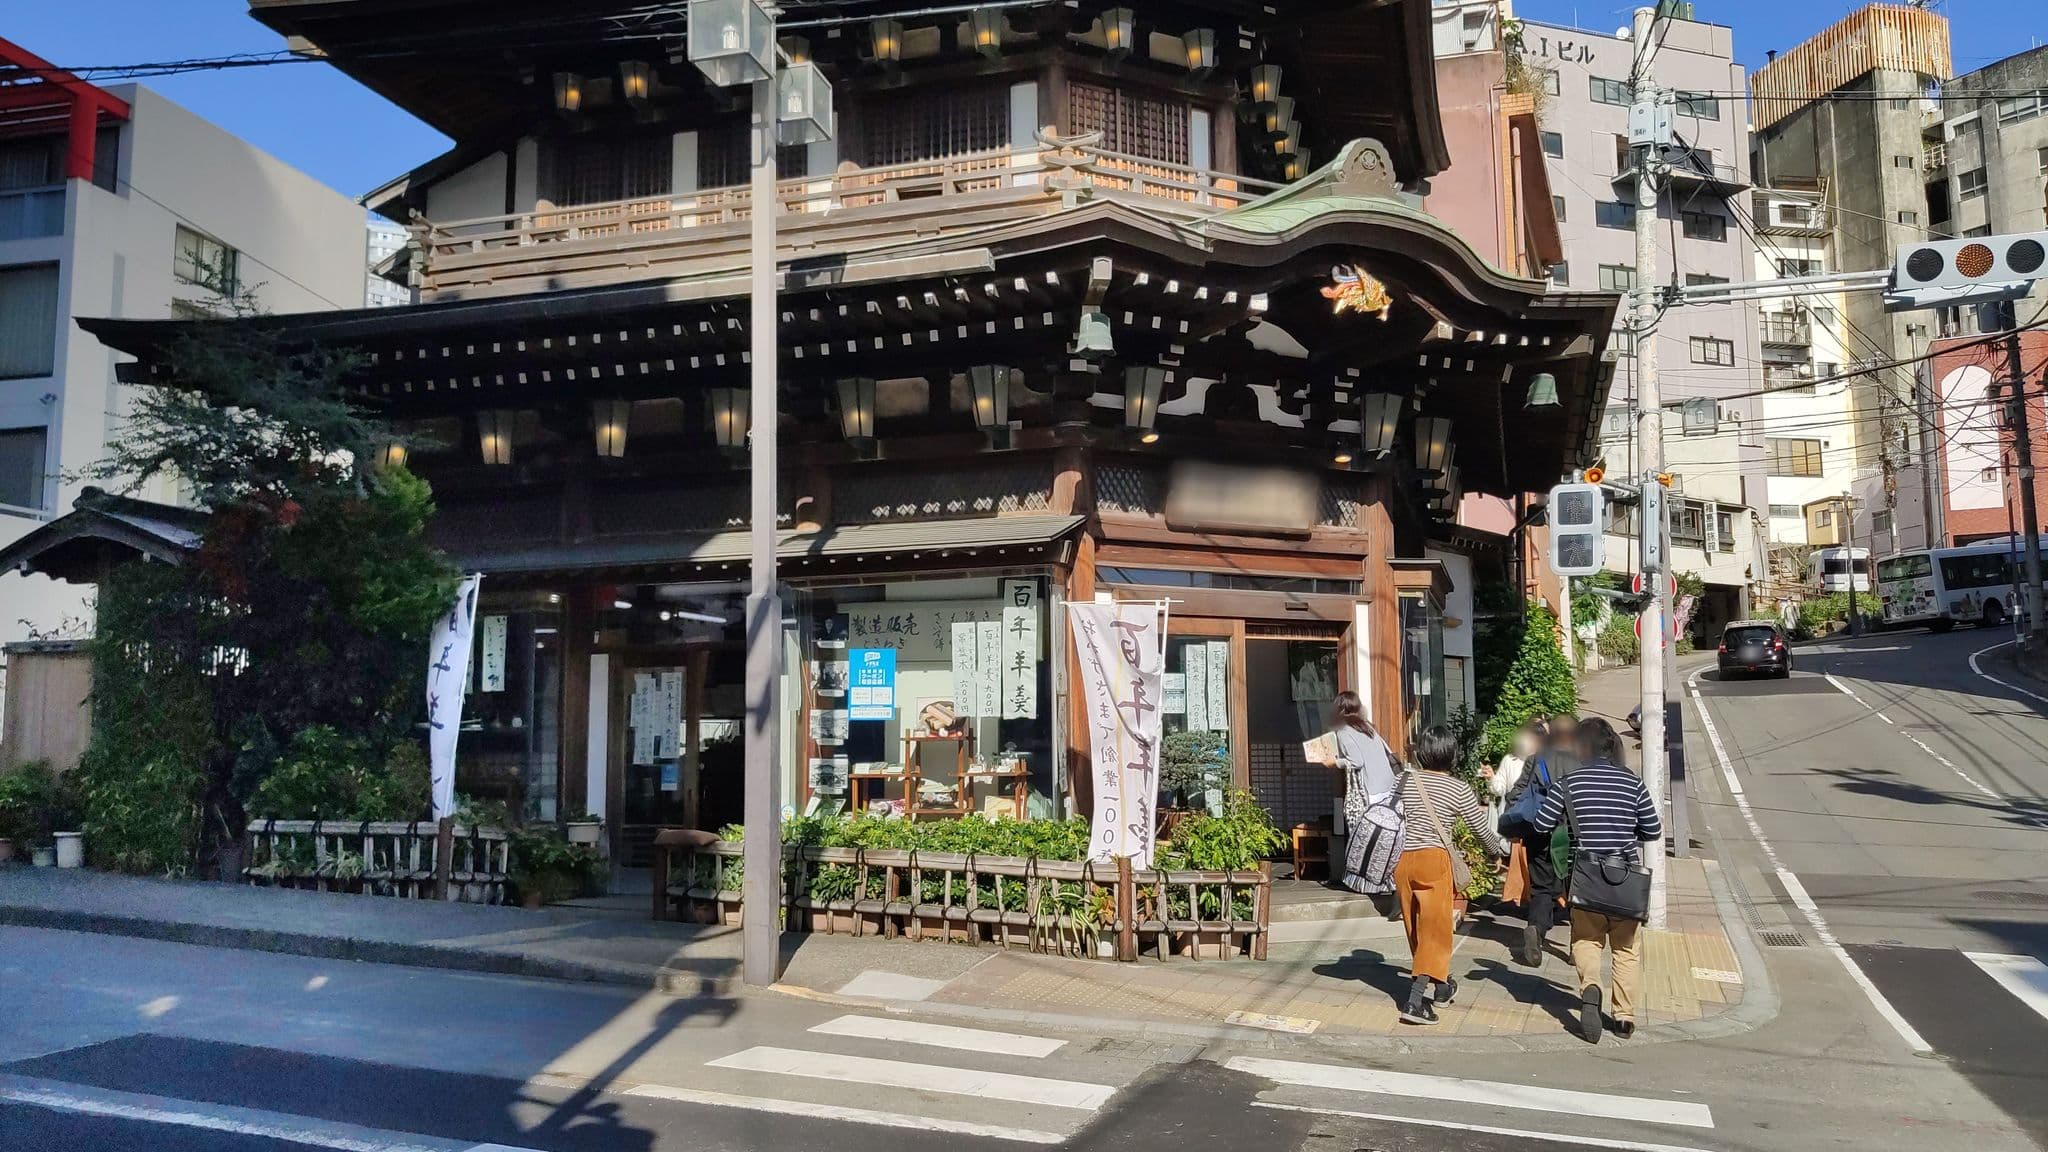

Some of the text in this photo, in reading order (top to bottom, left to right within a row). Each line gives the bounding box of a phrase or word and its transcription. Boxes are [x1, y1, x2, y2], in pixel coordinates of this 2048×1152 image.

[851, 612, 920, 637] 製造販売
[1009, 584, 1032, 714] 百年羊羹
